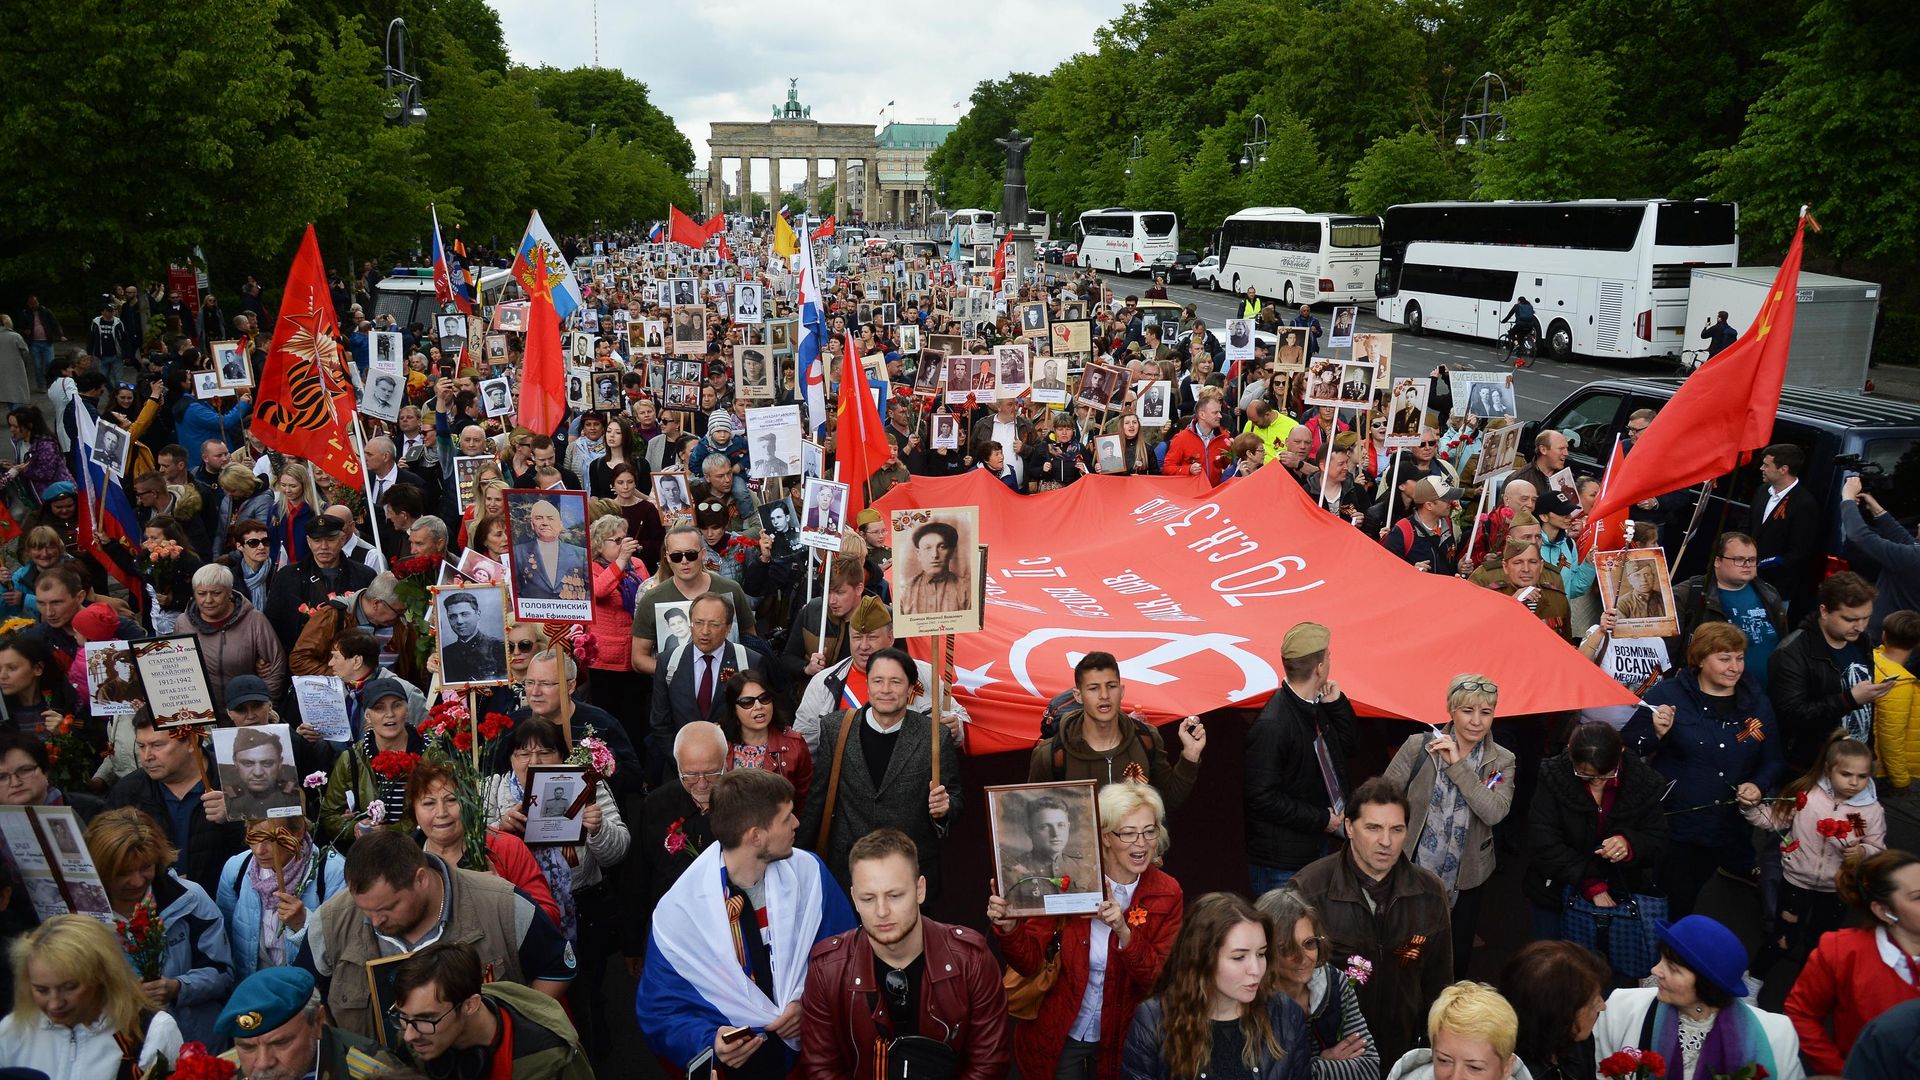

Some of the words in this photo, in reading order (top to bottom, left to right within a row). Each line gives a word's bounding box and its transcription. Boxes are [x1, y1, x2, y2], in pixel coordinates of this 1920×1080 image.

[1210, 555, 1326, 608] 79
[520, 602, 588, 610] ГОЛОВЯТИНСКИЙ
[546, 612, 585, 620] Ефимович
[1614, 645, 1659, 658] ВОЗМОЖНЫ
[148, 656, 188, 665] СТАРОДУБОВ
[151, 668, 194, 678] МИХАЙЛОВИЧ
[158, 677, 192, 686] 1912-1942
[175, 698, 202, 706] РЖЕВОМ
